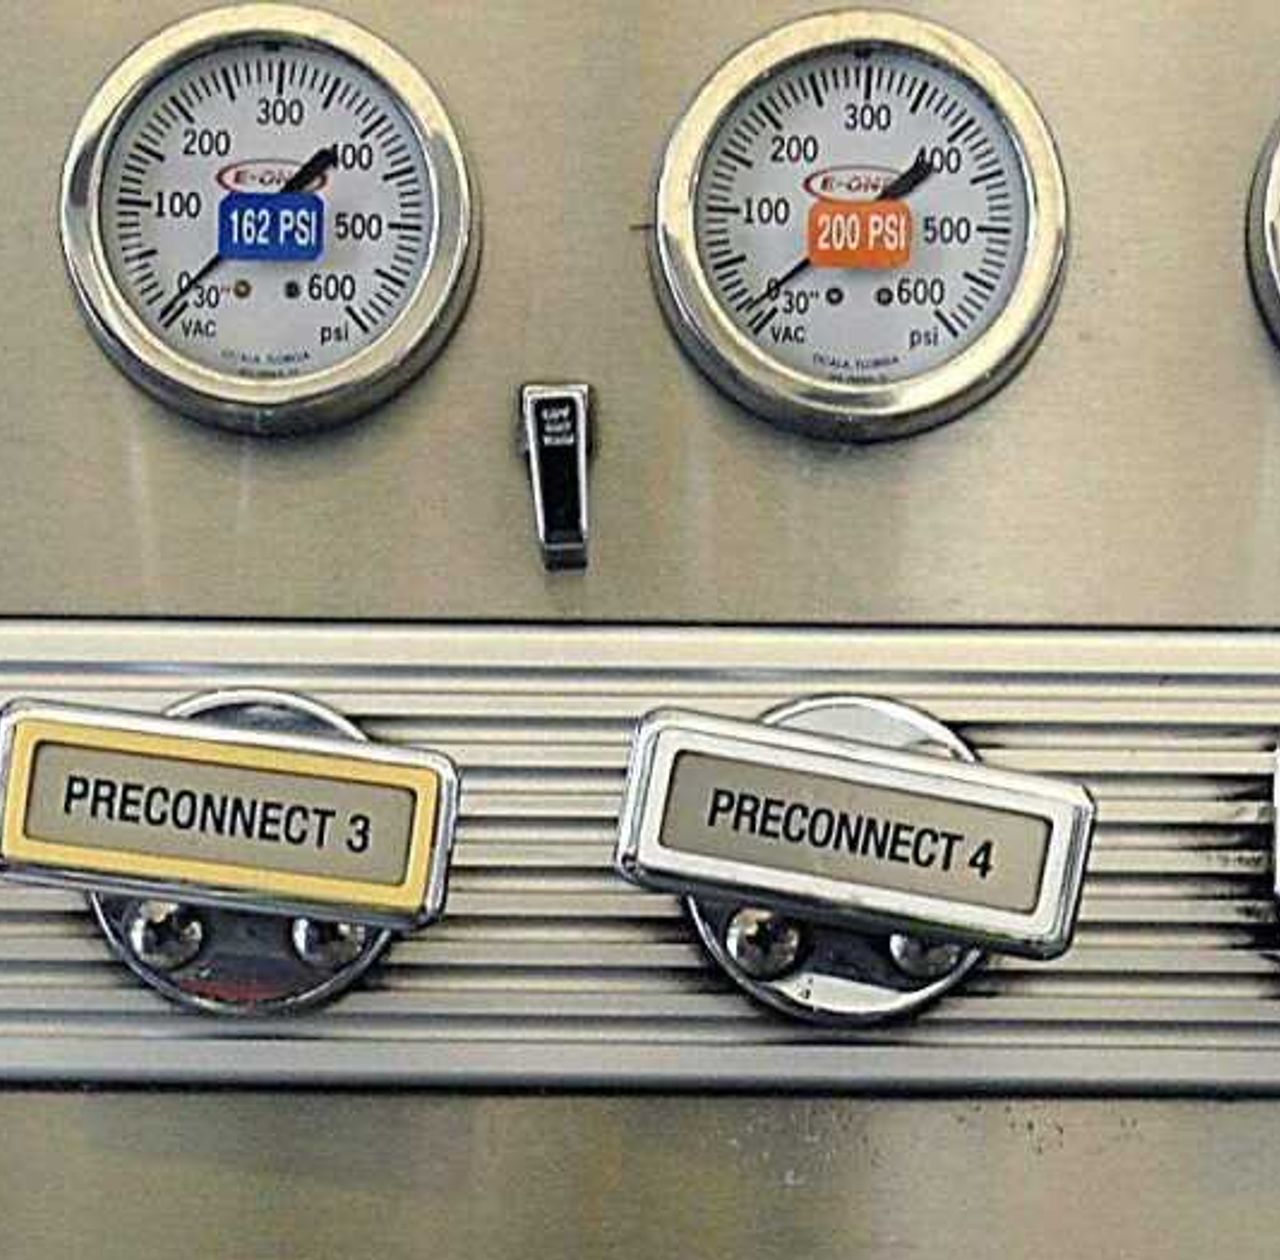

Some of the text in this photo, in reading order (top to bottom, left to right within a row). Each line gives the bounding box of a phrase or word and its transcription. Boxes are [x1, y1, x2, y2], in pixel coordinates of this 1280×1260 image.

[257, 100, 303, 126] 300
[845, 105, 891, 131] 300
[183, 131, 231, 156] 200
[772, 136, 818, 162] 200
[234, 170, 294, 186] E-ON
[821, 175, 890, 193] E-ON
[157, 192, 201, 218] 100
[744, 198, 789, 224] 100
[231, 209, 316, 245] 162 PSI
[336, 215, 382, 240] 500
[818, 214, 905, 249] 200 PSI
[924, 218, 970, 244] 500
[309, 275, 356, 301] 600
[897, 280, 944, 305] 600
[182, 321, 217, 338] VAC
[321, 322, 349, 345] psi
[772, 327, 805, 343] VAC
[910, 327, 938, 348] psi
[64, 775, 371, 853] PRECONNECT 3
[707, 788, 993, 877] PRECONNECT 4
